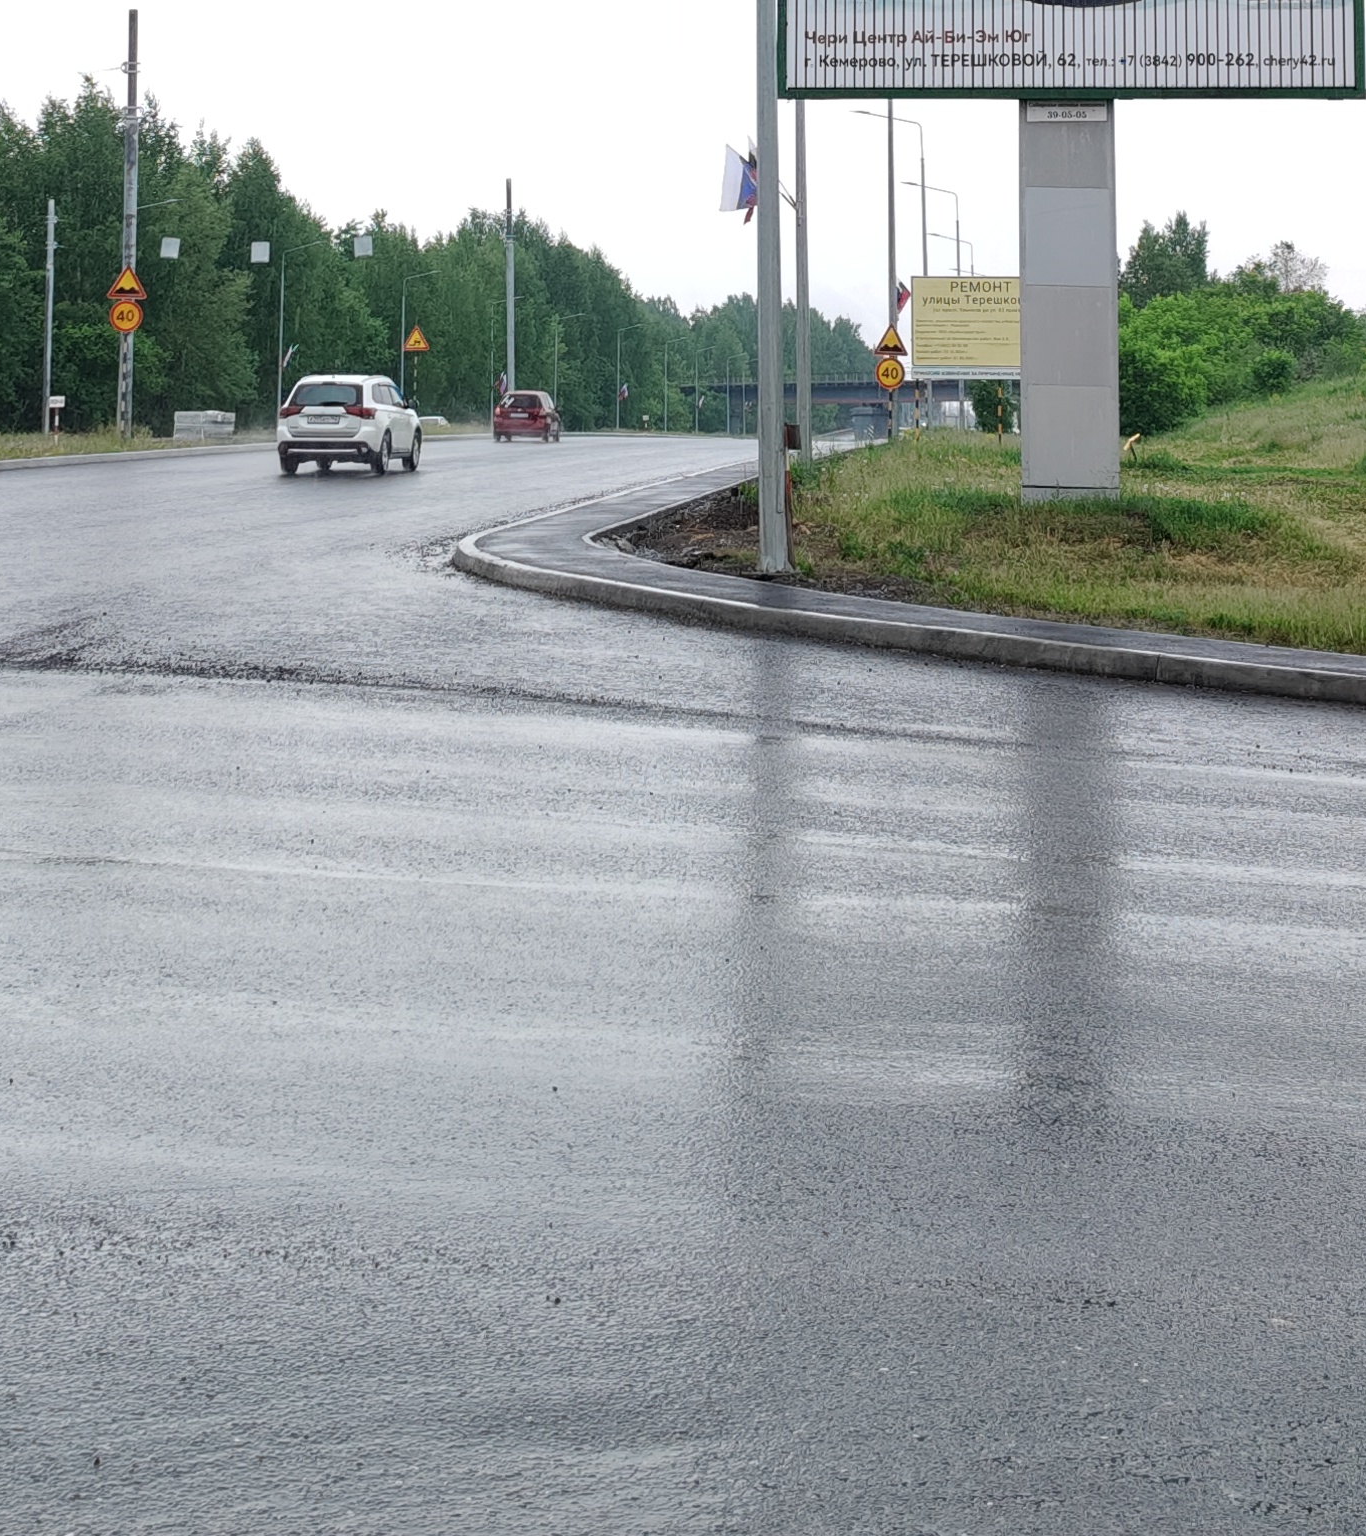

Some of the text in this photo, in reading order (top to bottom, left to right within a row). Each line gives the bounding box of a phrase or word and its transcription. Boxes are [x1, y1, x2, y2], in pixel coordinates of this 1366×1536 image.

[804, 28, 1032, 47] Чери Центр Ай-Би-Эм Юг
[818, 55, 900, 71] Кемерово,
[904, 56, 927, 70] ул.
[1056, 54, 1081, 69] 62,
[1139, 54, 1183, 69] (3842)
[1186, 52, 1259, 69] 900-262,
[1263, 54, 1336, 71] chery42.ru
[1046, 110, 1088, 119] 39-05-05
[950, 281, 1012, 293] РЕМОНТ
[922, 296, 961, 307] улицы
[115, 310, 135, 322] 40
[880, 367, 899, 380] 40
